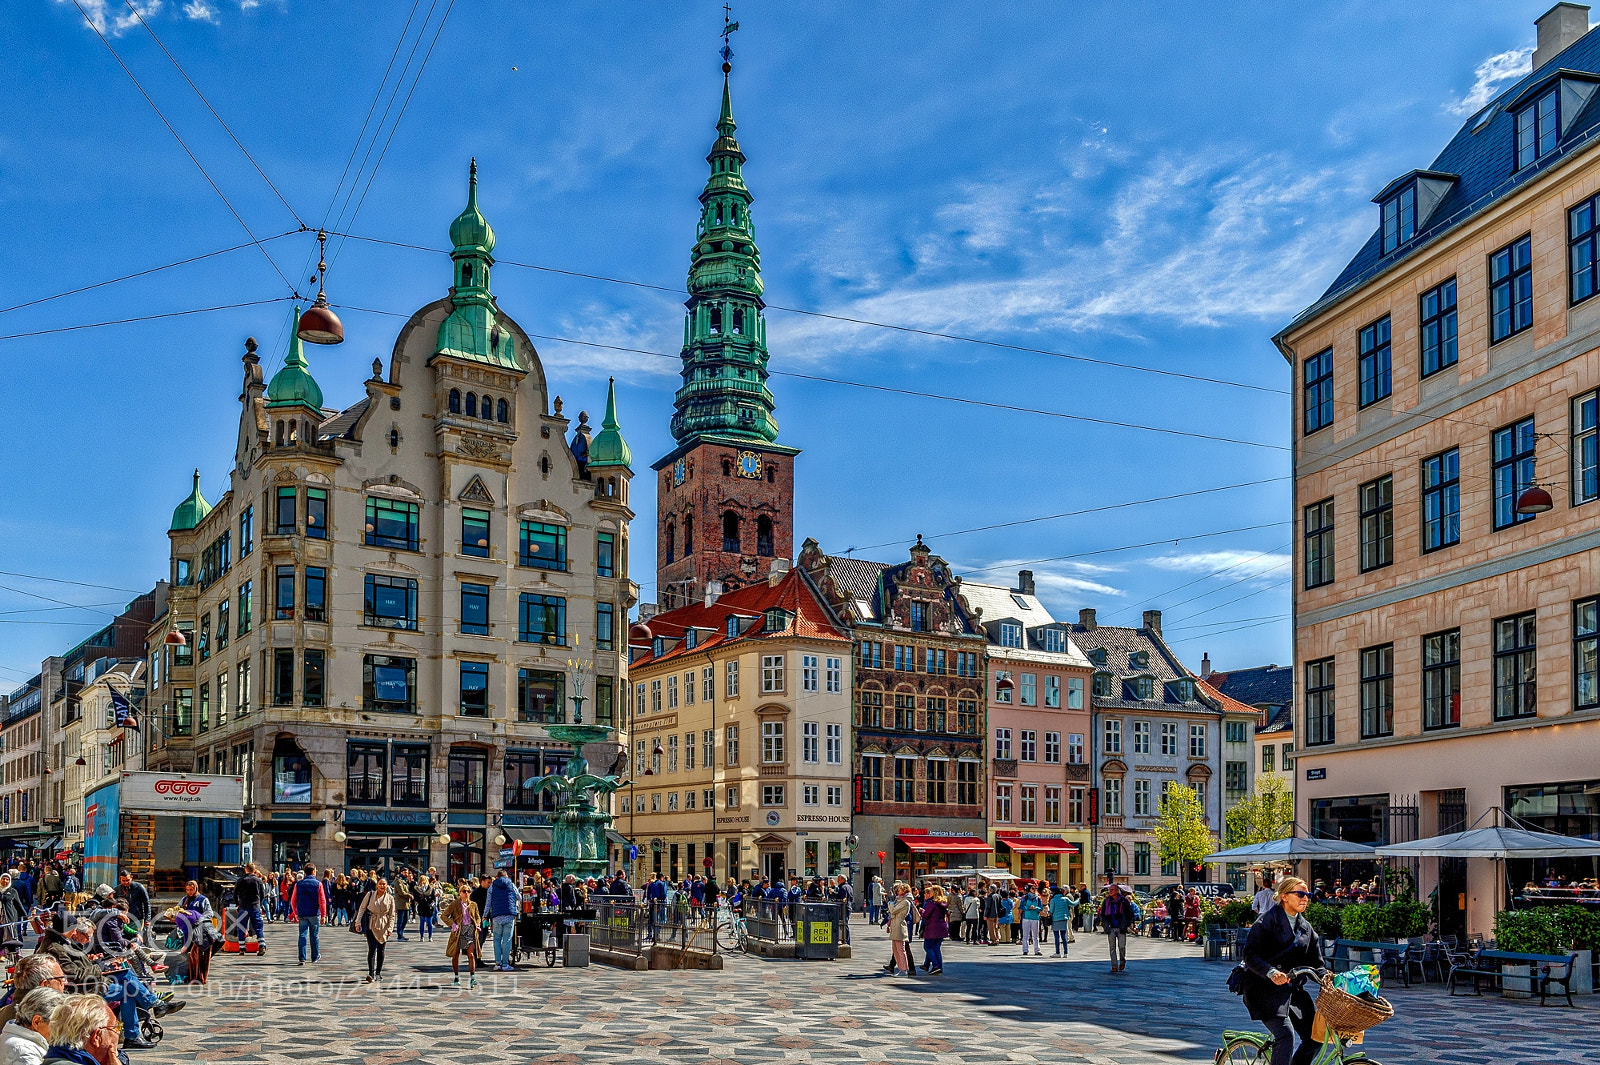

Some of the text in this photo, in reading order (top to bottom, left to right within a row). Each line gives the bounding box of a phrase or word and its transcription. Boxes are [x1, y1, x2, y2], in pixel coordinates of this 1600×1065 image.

[797, 814, 850, 823] ESPRESSO HOUSE
[1194, 885, 1219, 895] AVIS
